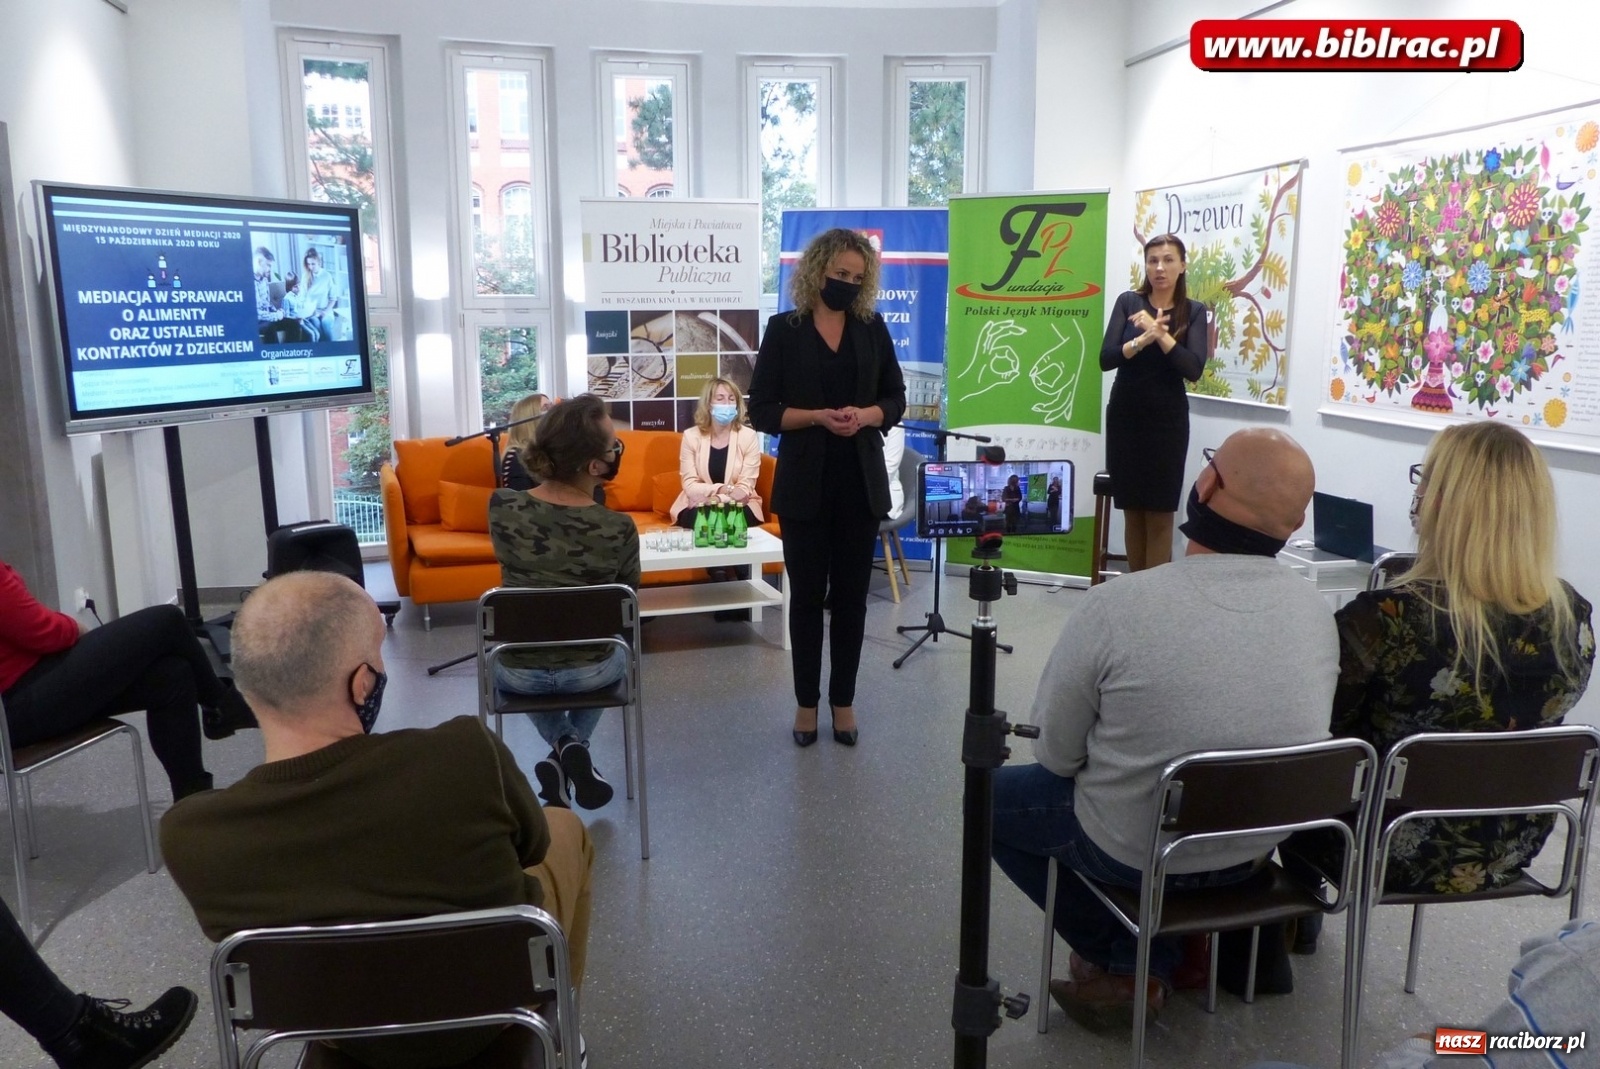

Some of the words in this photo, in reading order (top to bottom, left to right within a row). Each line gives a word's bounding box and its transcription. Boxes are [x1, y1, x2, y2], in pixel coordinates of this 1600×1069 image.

[1165, 193, 1243, 234] Drzewa
[63, 223, 152, 236] MIĘDZYNARODOWY
[155, 227, 181, 237] DZIEŃ
[183, 229, 220, 239] MEDIACJI
[223, 231, 241, 239] 2020
[650, 218, 685, 232] Miejska
[694, 218, 742, 230] Powiatowa
[95, 236, 106, 244] 15
[109, 236, 173, 247] PAŹDZIERNIKA
[176, 239, 195, 247] 2020
[197, 240, 220, 248] ROKU
[600, 232, 742, 264] Biblioteka
[657, 265, 732, 285] Publiczna
[78, 290, 152, 306] MEDIACJA
[154, 291, 168, 303] W
[171, 290, 243, 303] SPRAWACH
[122, 308, 134, 322] O
[137, 308, 207, 321] ALIMENTY
[965, 306, 1000, 316] Polski
[1003, 306, 1037, 318] Język
[1040, 306, 1089, 318] Migowy
[110, 327, 150, 341] ORAZ
[153, 324, 225, 339] USTALENIE
[77, 341, 172, 361] KONTAKTÓW
[175, 344, 184, 356] Z
[187, 340, 253, 355] DZIECKIEM
[261, 349, 314, 360] Organizatorzy:
[641, 418, 665, 428] muzyka
